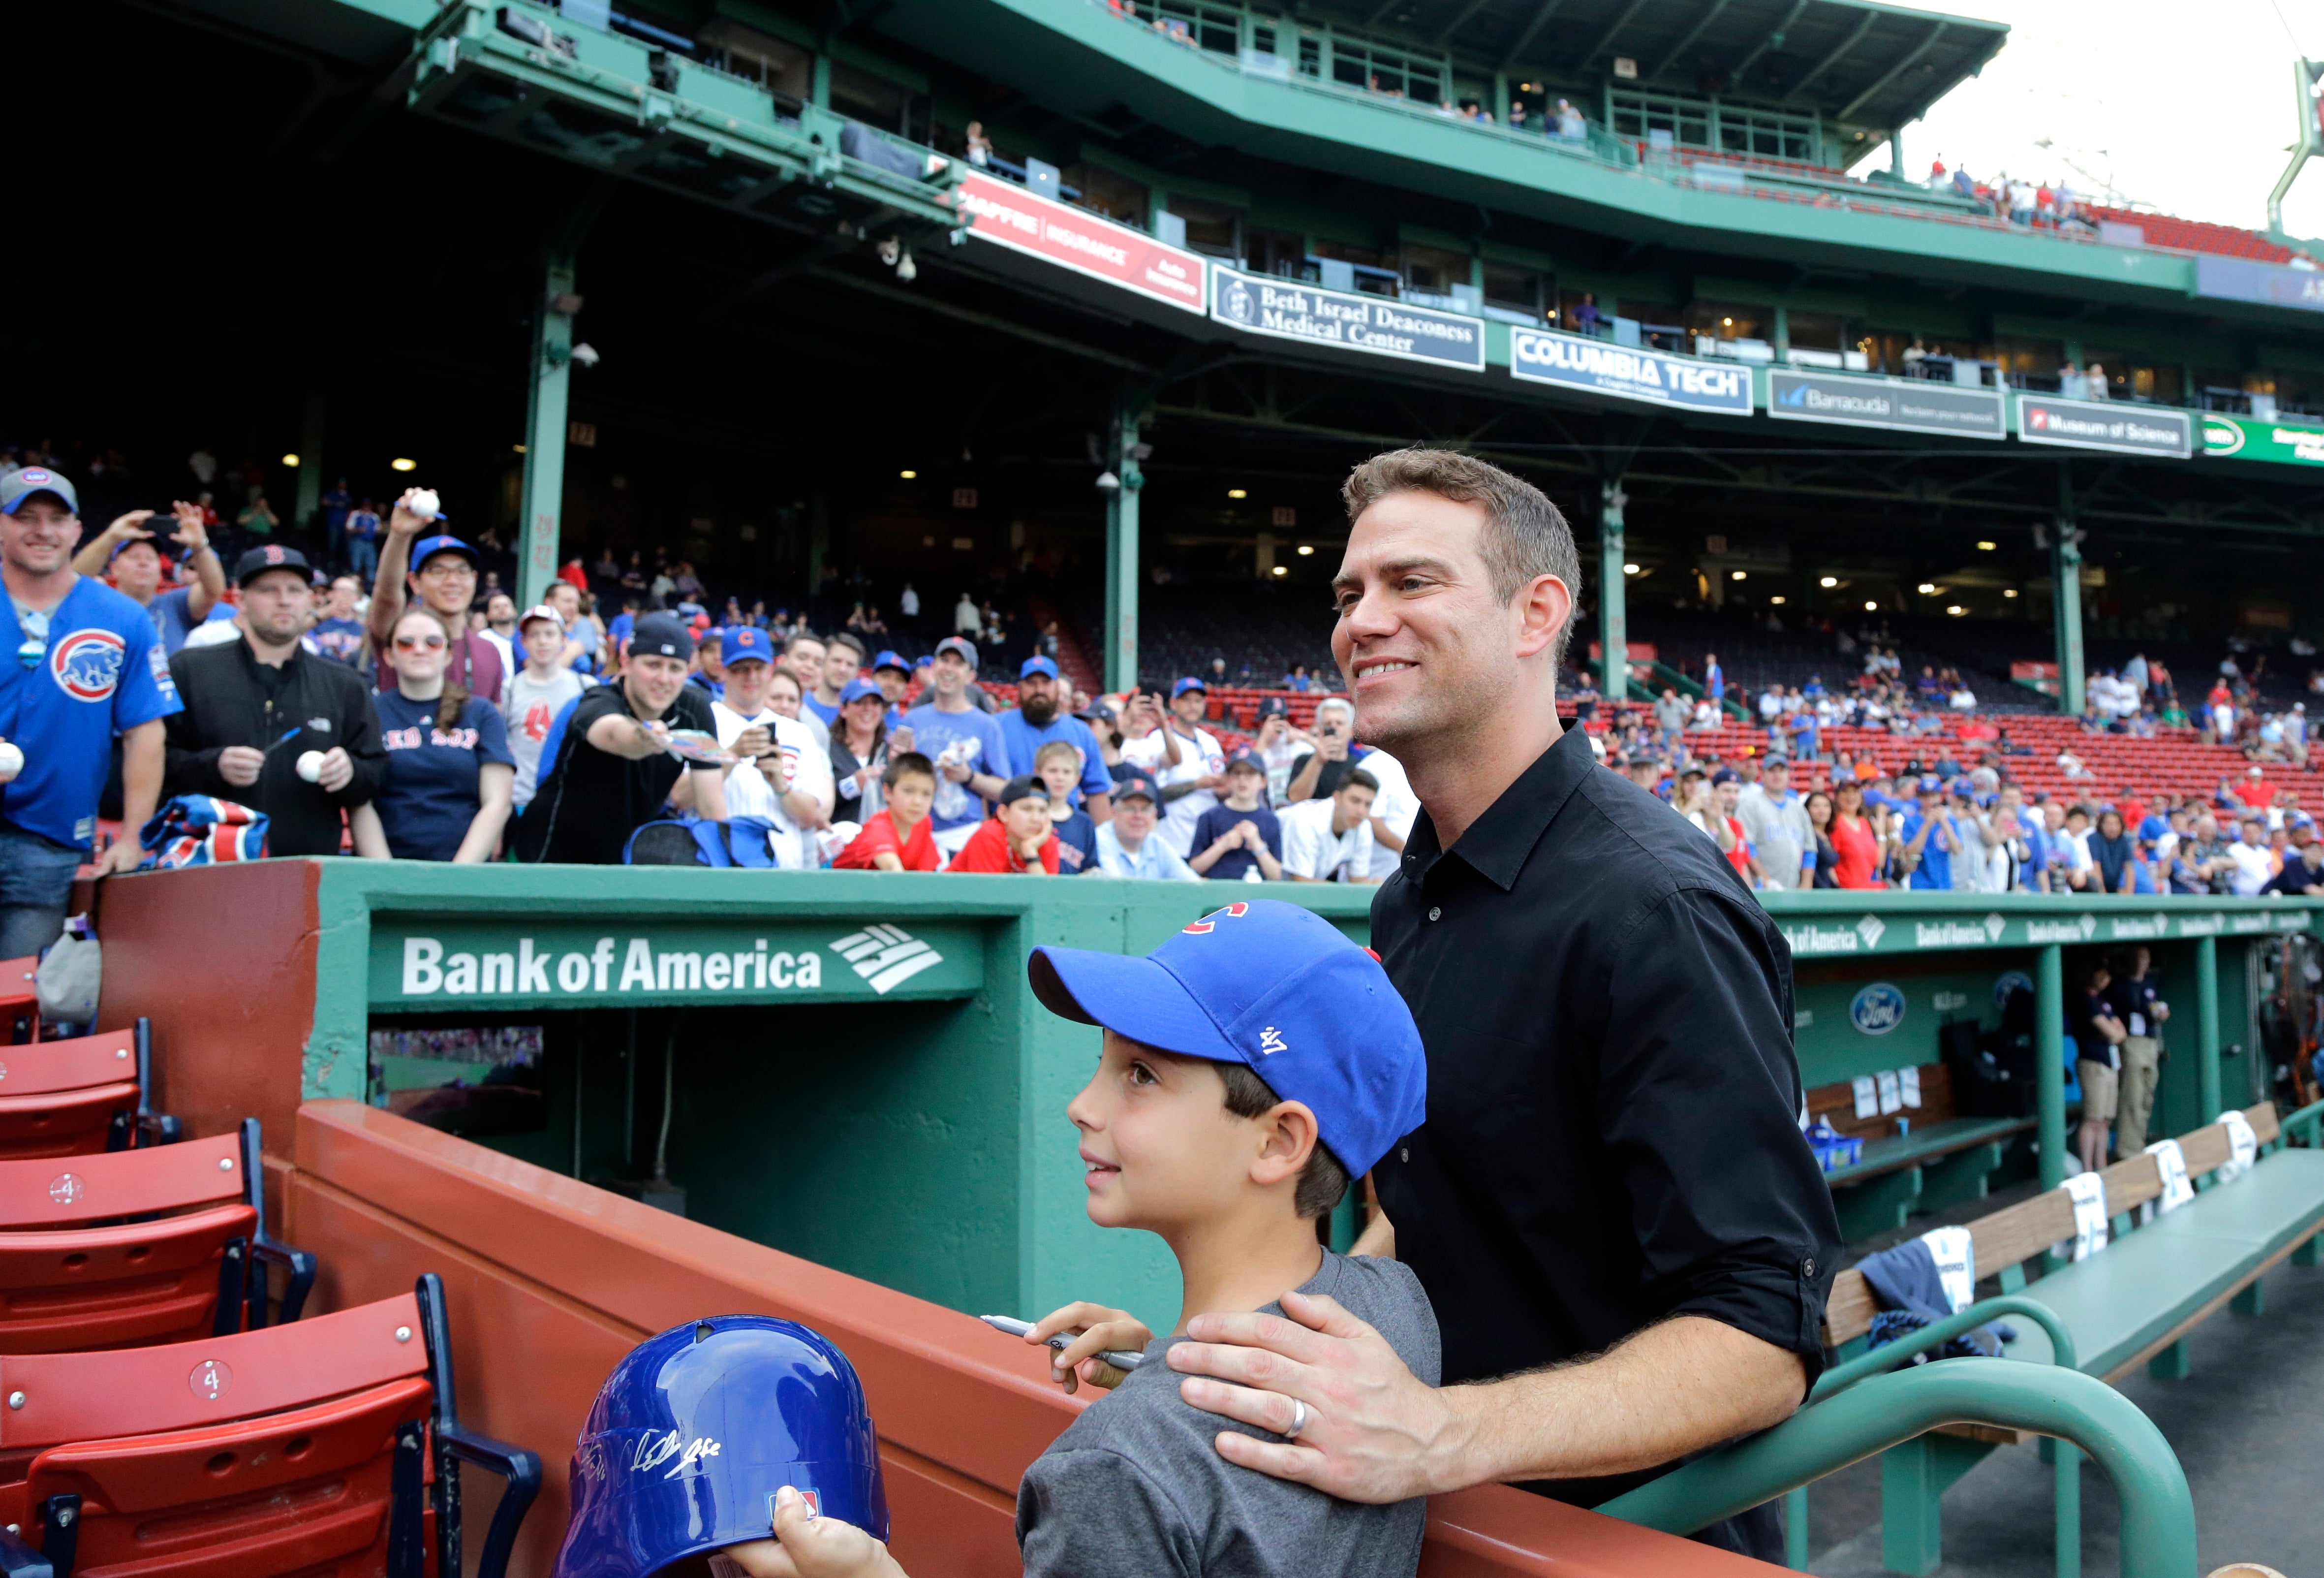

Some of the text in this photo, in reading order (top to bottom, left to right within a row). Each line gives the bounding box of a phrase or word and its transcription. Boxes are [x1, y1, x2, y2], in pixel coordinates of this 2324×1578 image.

[1046, 223, 1127, 266] INSURANCE
[1261, 286, 1474, 343] Beth Israel Deaconess
[1261, 310, 1415, 352] Medical Center
[1517, 334, 1739, 397] COLUMBIA TECH
[1805, 388, 1890, 415] Barracuda
[2047, 414, 2180, 445] Museum of Science
[264, 544, 285, 565] B
[738, 631, 755, 646] C
[1809, 925, 1858, 951] America
[402, 936, 822, 995] Bank of America
[204, 1369, 220, 1390] 4
